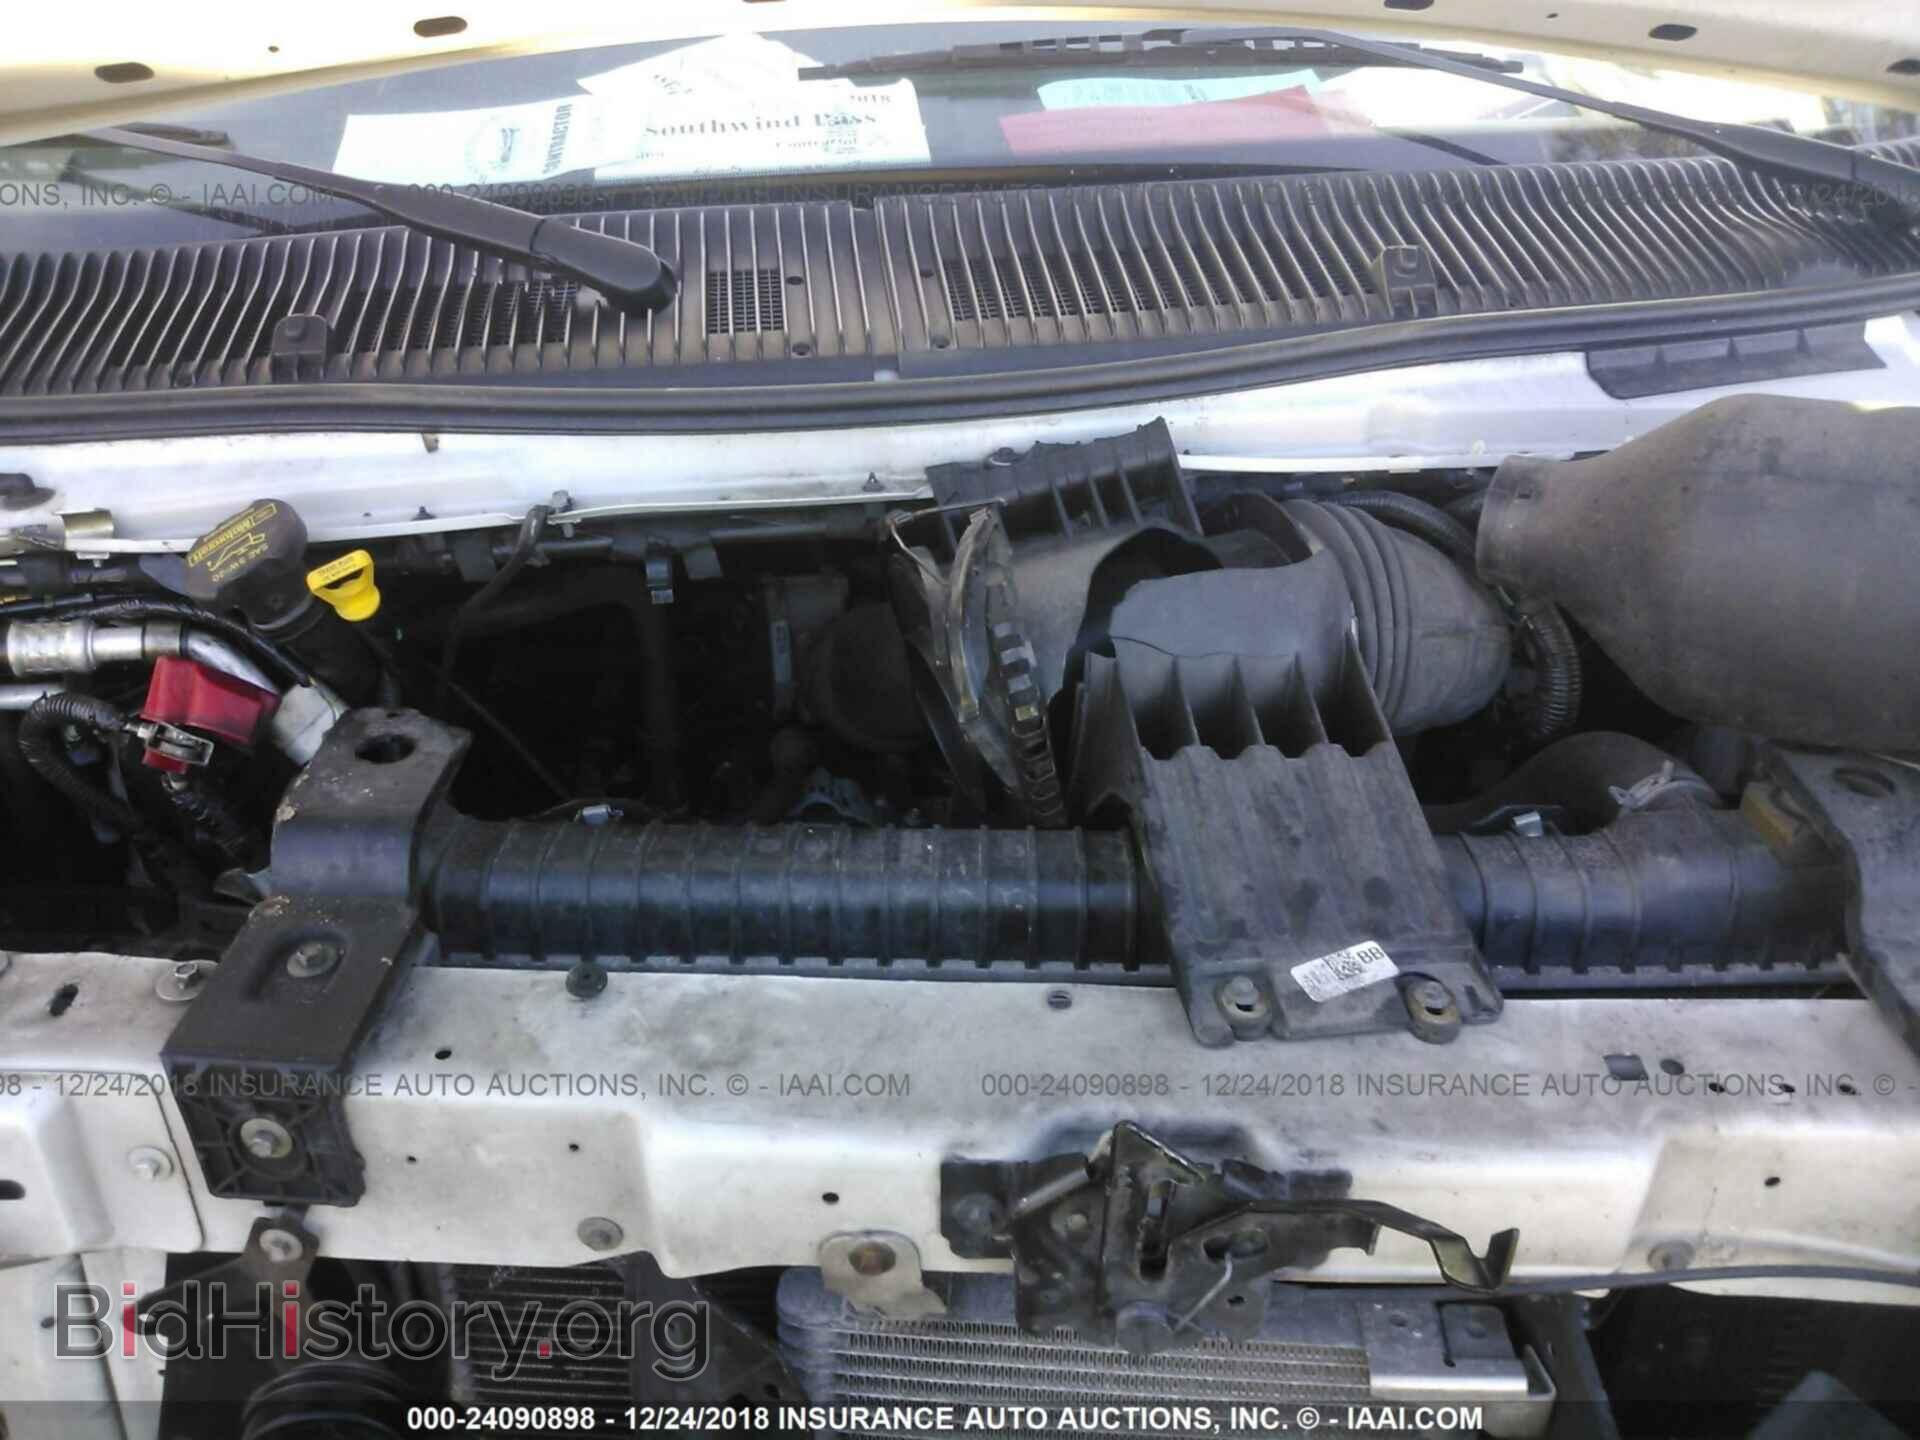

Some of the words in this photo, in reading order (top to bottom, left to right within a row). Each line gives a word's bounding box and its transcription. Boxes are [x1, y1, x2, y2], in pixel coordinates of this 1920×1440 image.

[644, 114, 802, 136] Southwind
[542, 103, 574, 175] CONTRACTOR
[1356, 946, 1385, 964] BB
